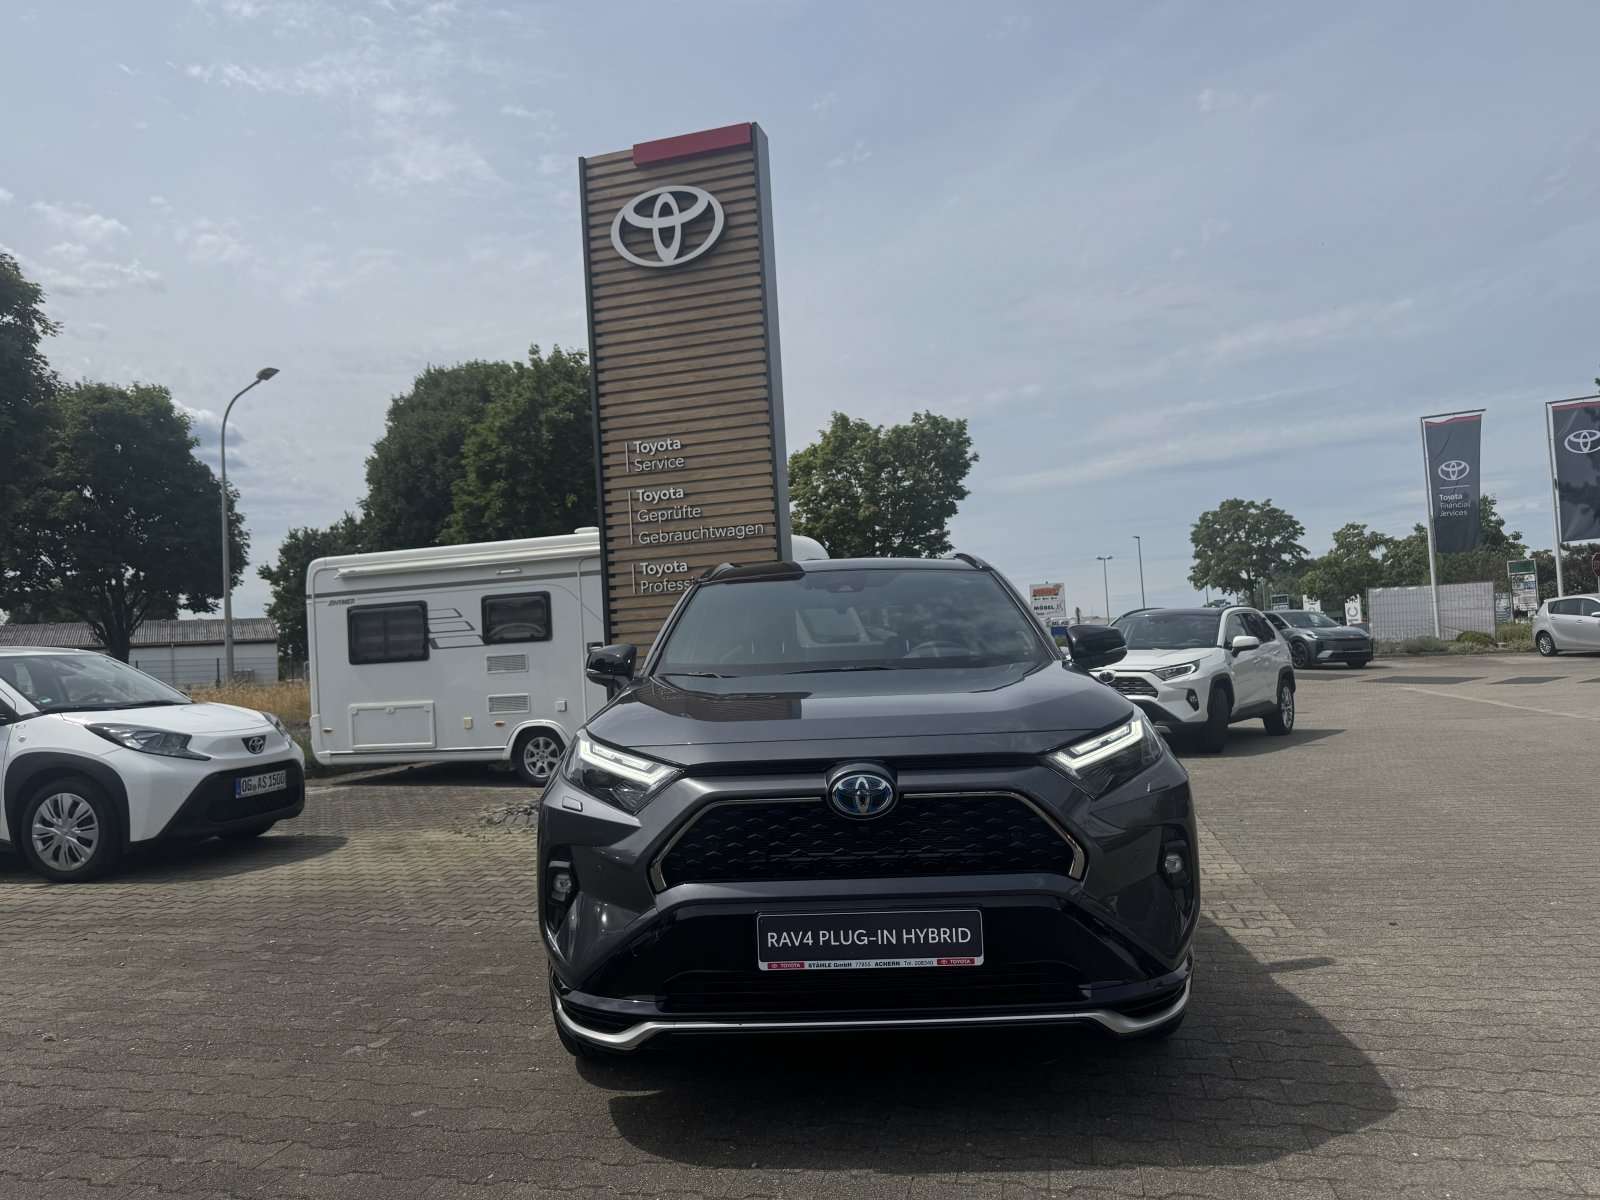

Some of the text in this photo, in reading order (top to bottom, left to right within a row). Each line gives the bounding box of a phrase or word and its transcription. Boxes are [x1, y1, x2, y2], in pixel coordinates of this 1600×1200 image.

[633, 438, 681, 455] Toyota
[634, 456, 685, 472] Service
[636, 487, 684, 504] Toyota
[1439, 494, 1463, 502] Toyota
[637, 505, 701, 523] Geprüfte
[638, 524, 764, 545] Gebrauchtwagen
[640, 560, 688, 577] Toyota
[257, 776, 268, 790] AS
[767, 927, 971, 948] RAV4 PLUG-IN HYBRID
